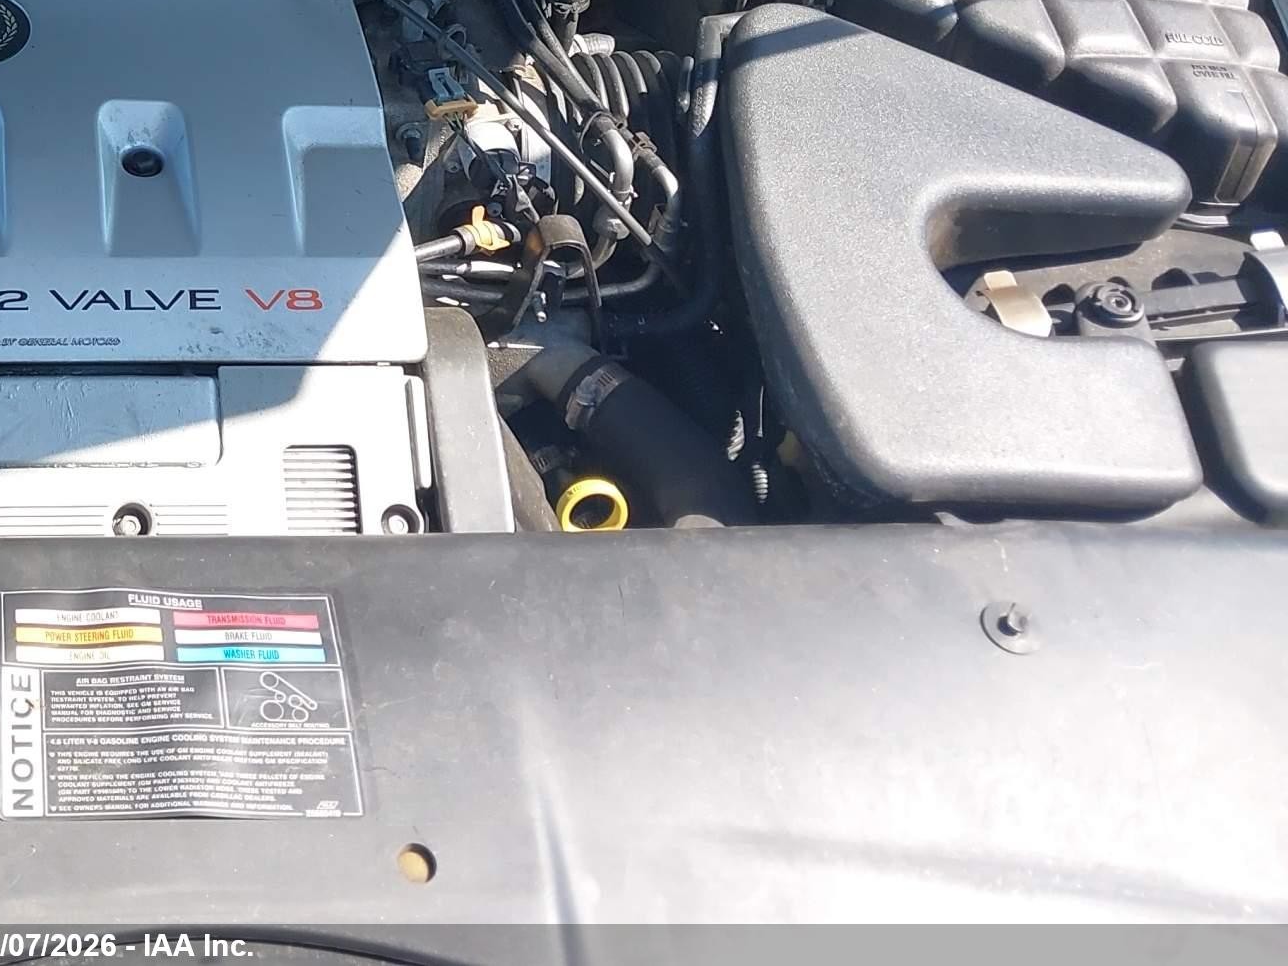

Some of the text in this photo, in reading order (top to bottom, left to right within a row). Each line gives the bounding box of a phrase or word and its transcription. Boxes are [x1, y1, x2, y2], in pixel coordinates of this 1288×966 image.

[49, 290, 221, 310] VALVE
[244, 289, 324, 310] V8
[1, 338, 17, 346] BY
[18, 338, 69, 346] GENERAL
[71, 338, 121, 346] MOTORS
[128, 594, 203, 607] FLUID USAGE
[86, 610, 119, 621] COOLANT
[207, 614, 286, 624] TRANSMISSION FLUID
[45, 628, 134, 642] POWER STEERING FLUID
[225, 632, 272, 641] BRAKE FLUID
[223, 649, 280, 659] WASHER FLUID
[110, 674, 152, 684] RESTRAINT
[11, 673, 33, 810] NOTICE
[100, 737, 139, 745] GASOLINE
[140, 735, 170, 743] ENGINE
[171, 734, 207, 742] COOLING
[209, 734, 240, 743] SYSTEM
[241, 737, 296, 745] MAINTENANCE
[298, 737, 345, 745] PROCEDURE
